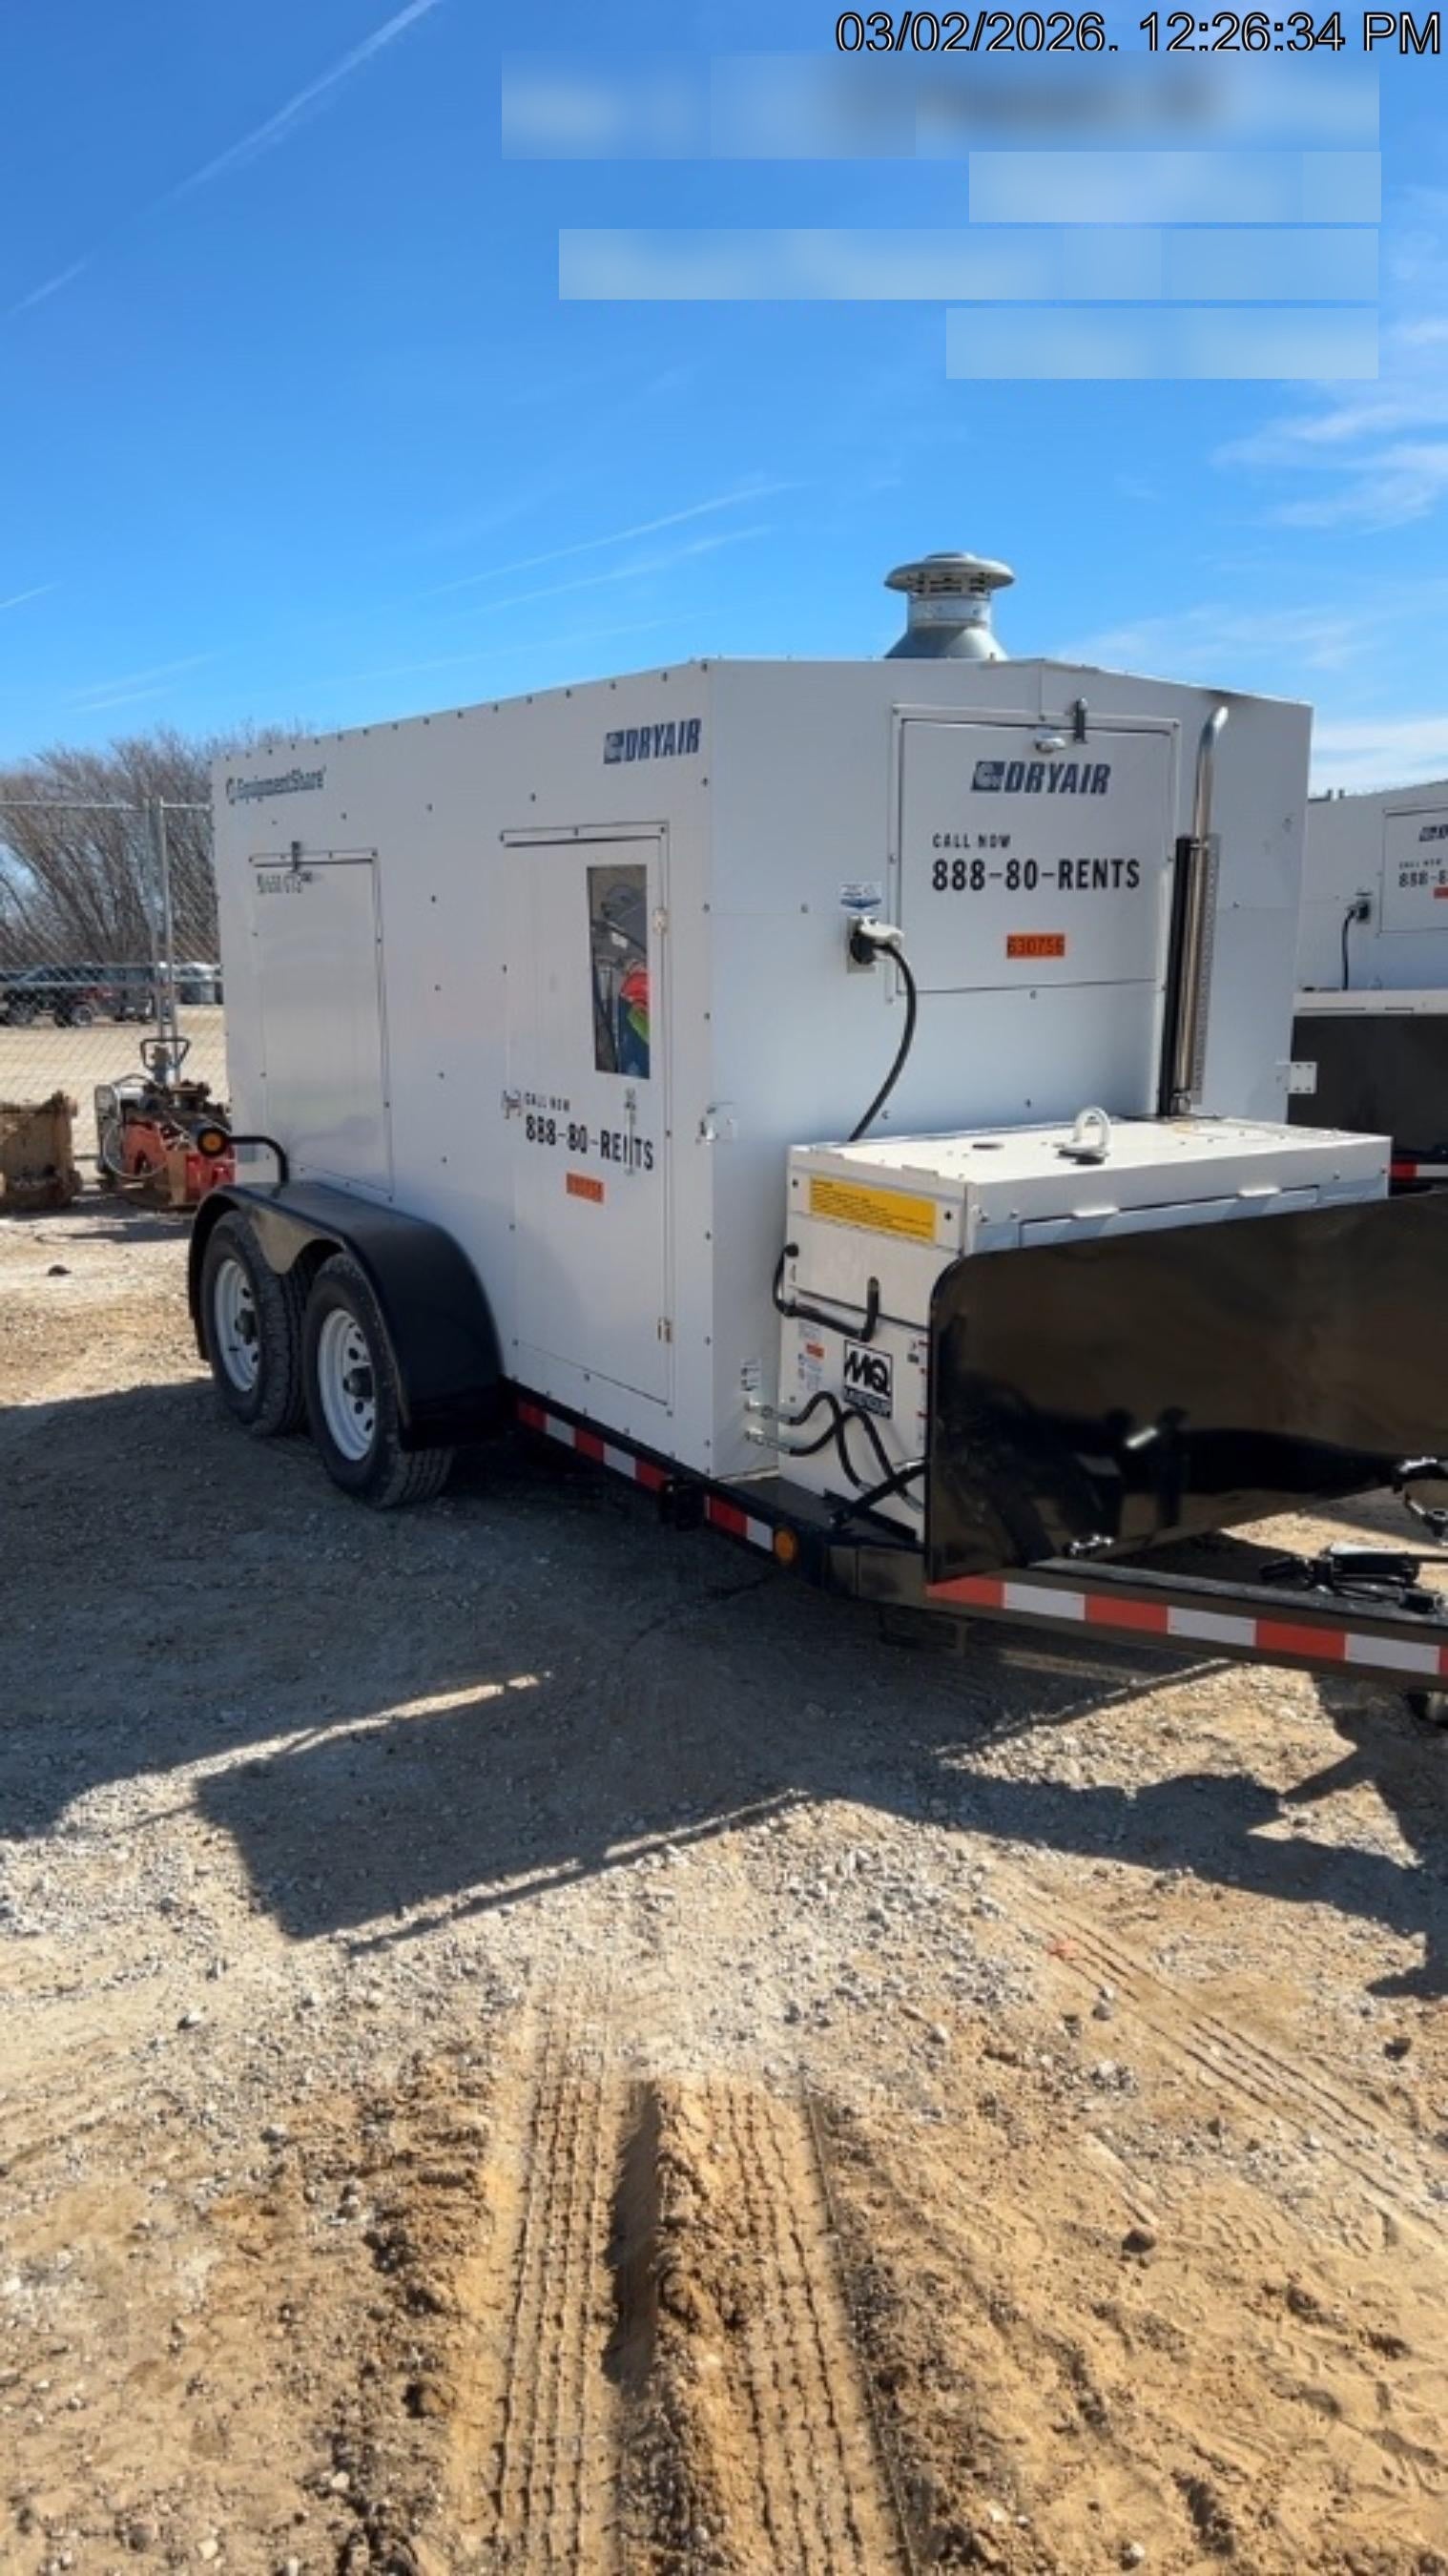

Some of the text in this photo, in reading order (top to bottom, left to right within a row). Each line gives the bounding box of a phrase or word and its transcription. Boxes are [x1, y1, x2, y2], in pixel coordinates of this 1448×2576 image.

[625, 717, 702, 762] DRYAIR
[1003, 761, 1111, 795] DRYAIR
[932, 833, 1011, 849] CALL NOW
[932, 858, 1142, 891] 888-80-RENTS
